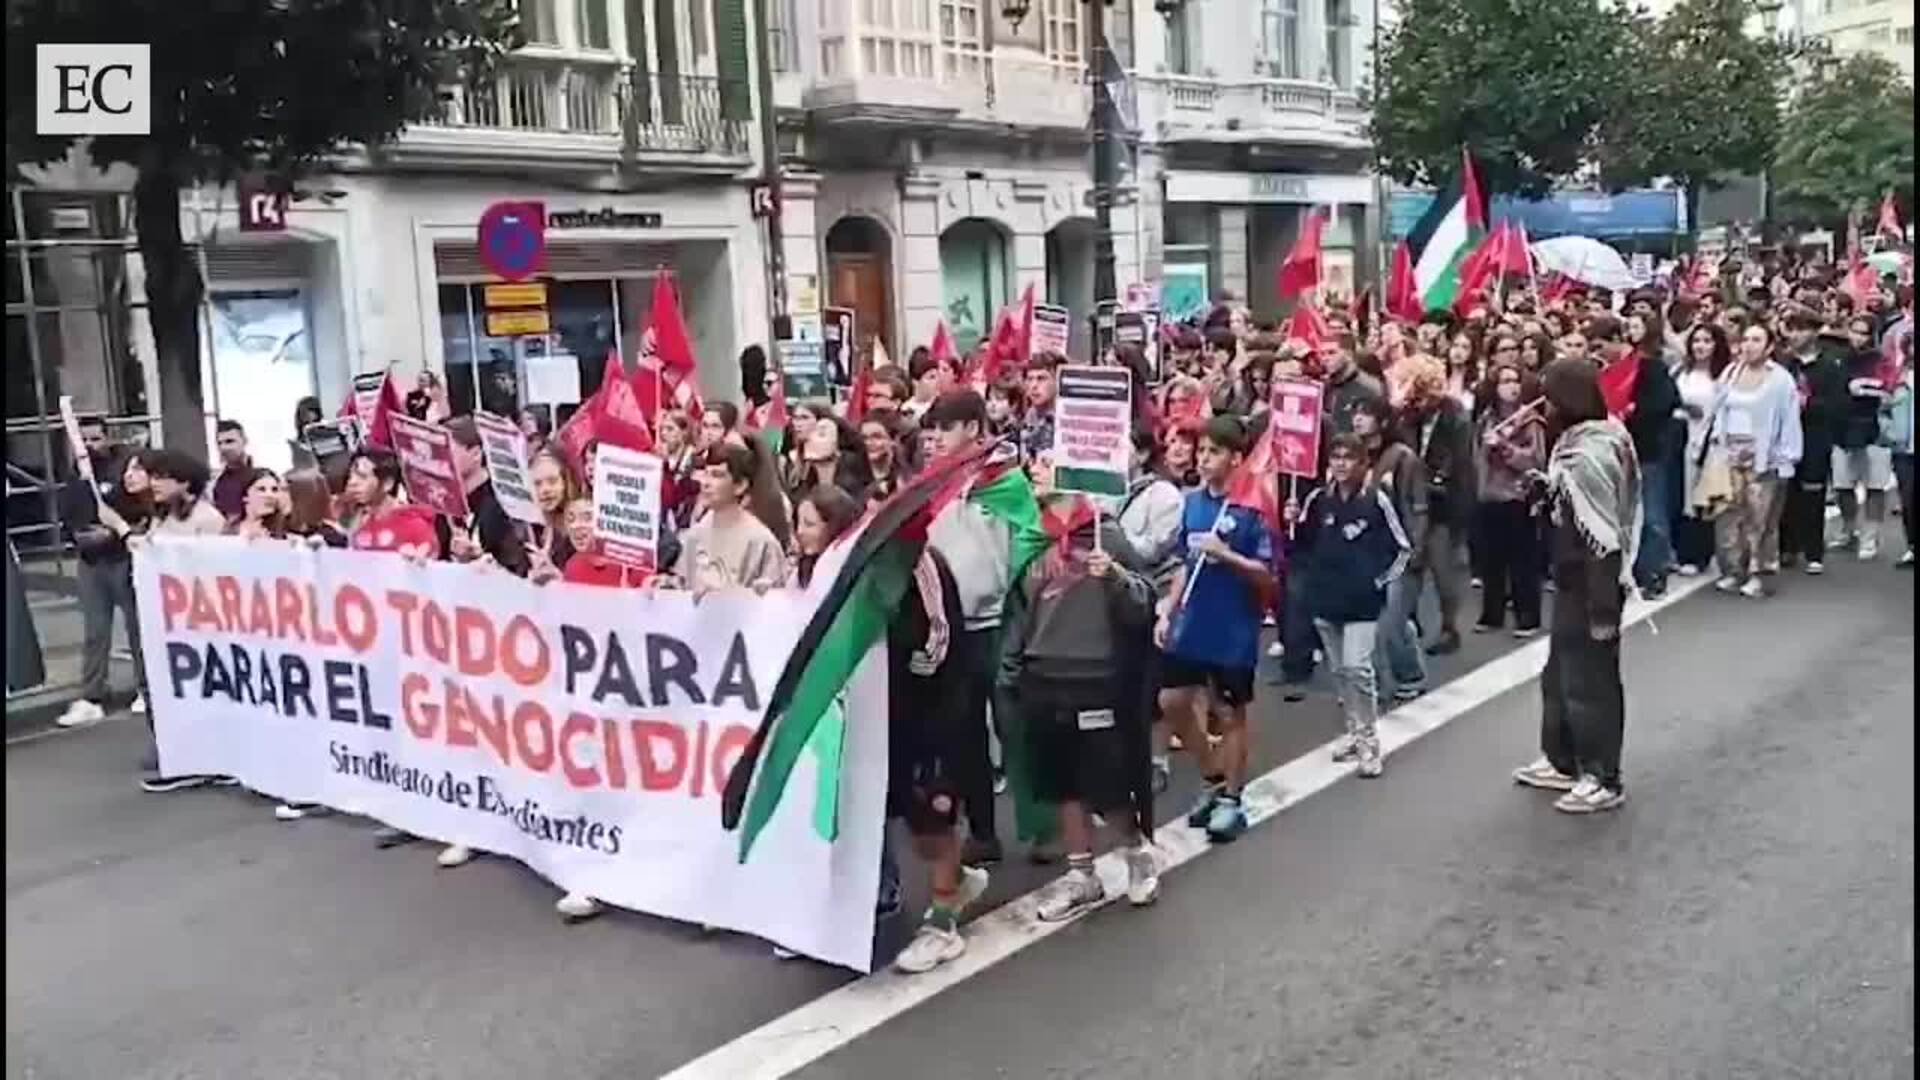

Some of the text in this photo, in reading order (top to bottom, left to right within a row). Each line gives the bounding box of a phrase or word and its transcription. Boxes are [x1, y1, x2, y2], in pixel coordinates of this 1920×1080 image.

[159, 573, 760, 711] PARARLO TODO PARA
[166, 641, 317, 718] PARAR
[323, 659, 392, 731] EL
[329, 740, 623, 854] Sindicato de Esdiantes
